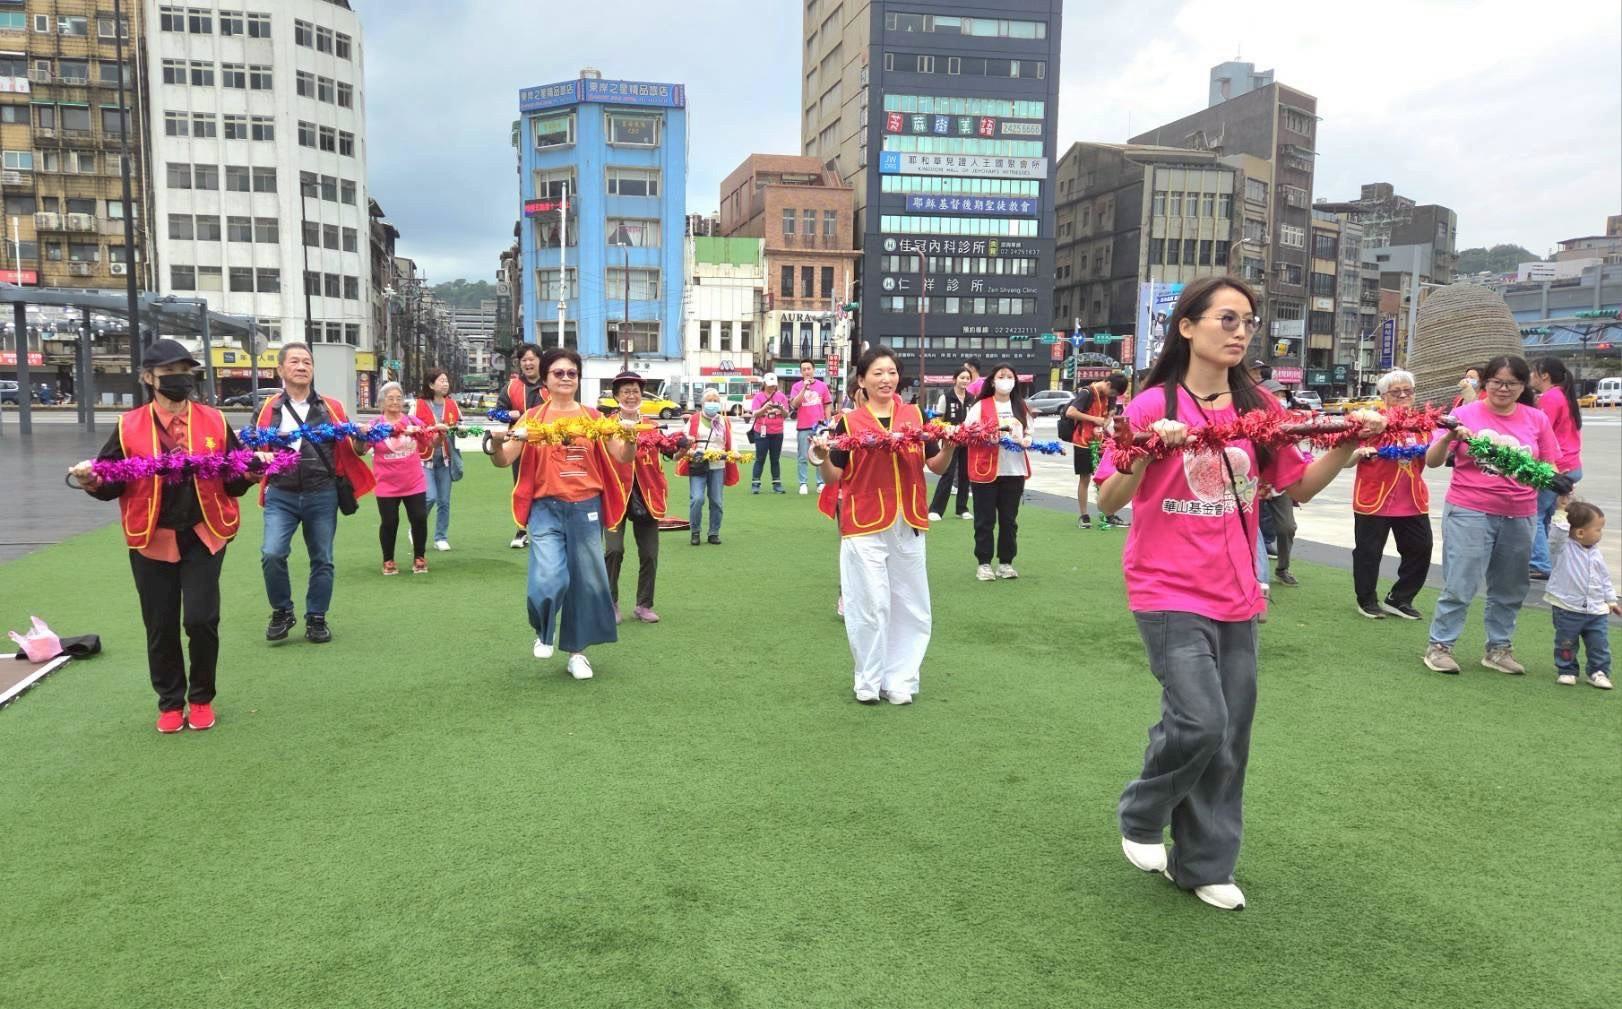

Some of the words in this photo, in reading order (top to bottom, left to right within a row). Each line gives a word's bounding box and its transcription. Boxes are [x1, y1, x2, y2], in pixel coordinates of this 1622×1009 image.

[888, 112, 996, 137] 芝麻街美語
[913, 197, 1031, 212] 耶穌基督後期聖徒教會
[900, 239, 985, 255] 佳冠內科診所
[1163, 500, 1224, 515] 華山基金會
